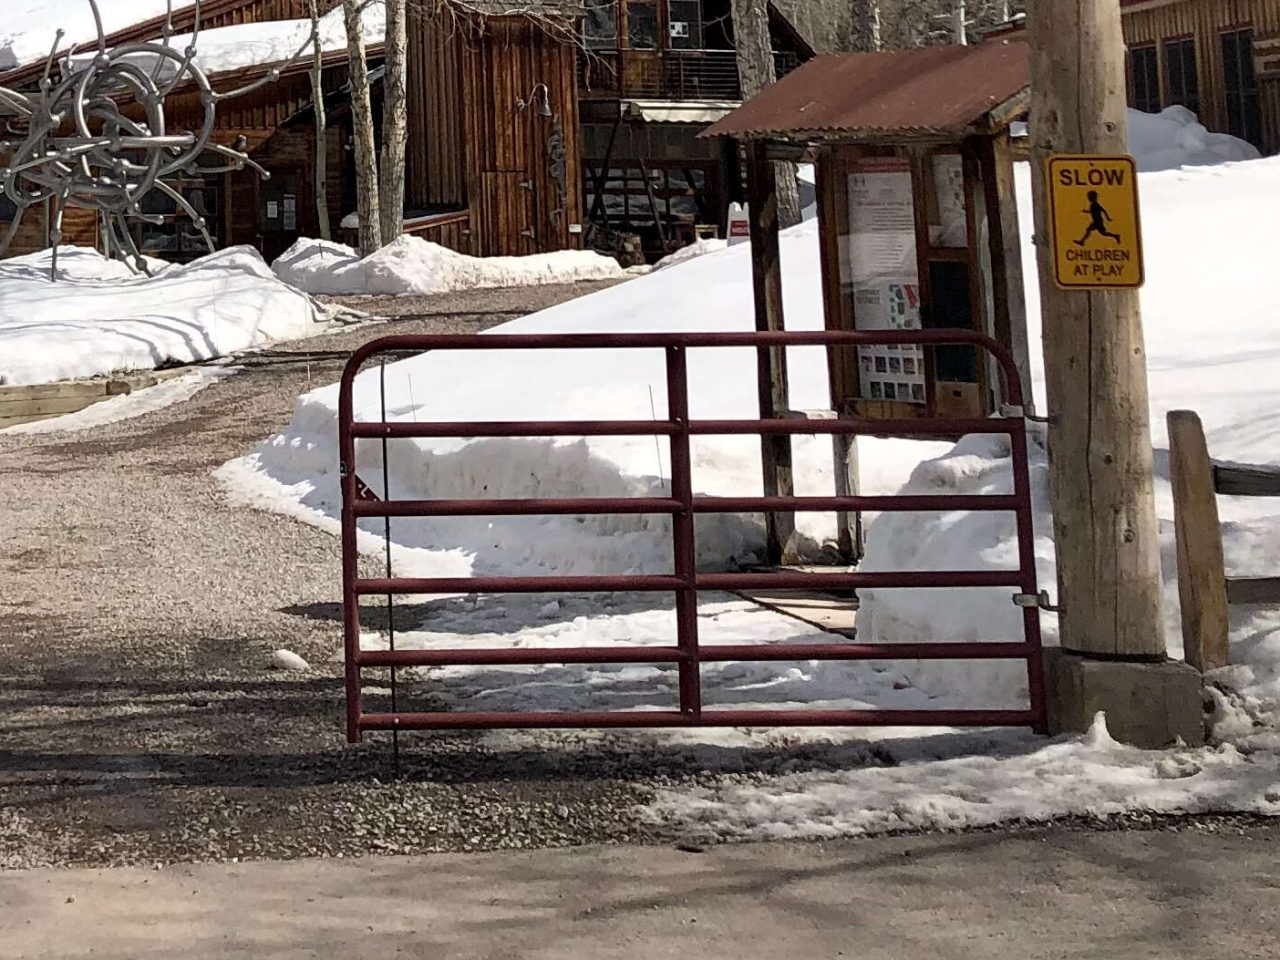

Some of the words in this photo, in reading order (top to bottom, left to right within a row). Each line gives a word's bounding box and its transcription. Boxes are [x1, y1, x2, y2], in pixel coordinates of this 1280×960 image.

[1059, 168, 1125, 186] SLOW
[1065, 249, 1130, 261] CHILDREN
[1074, 265, 1089, 276] AT
[1092, 265, 1124, 276] PLAY
